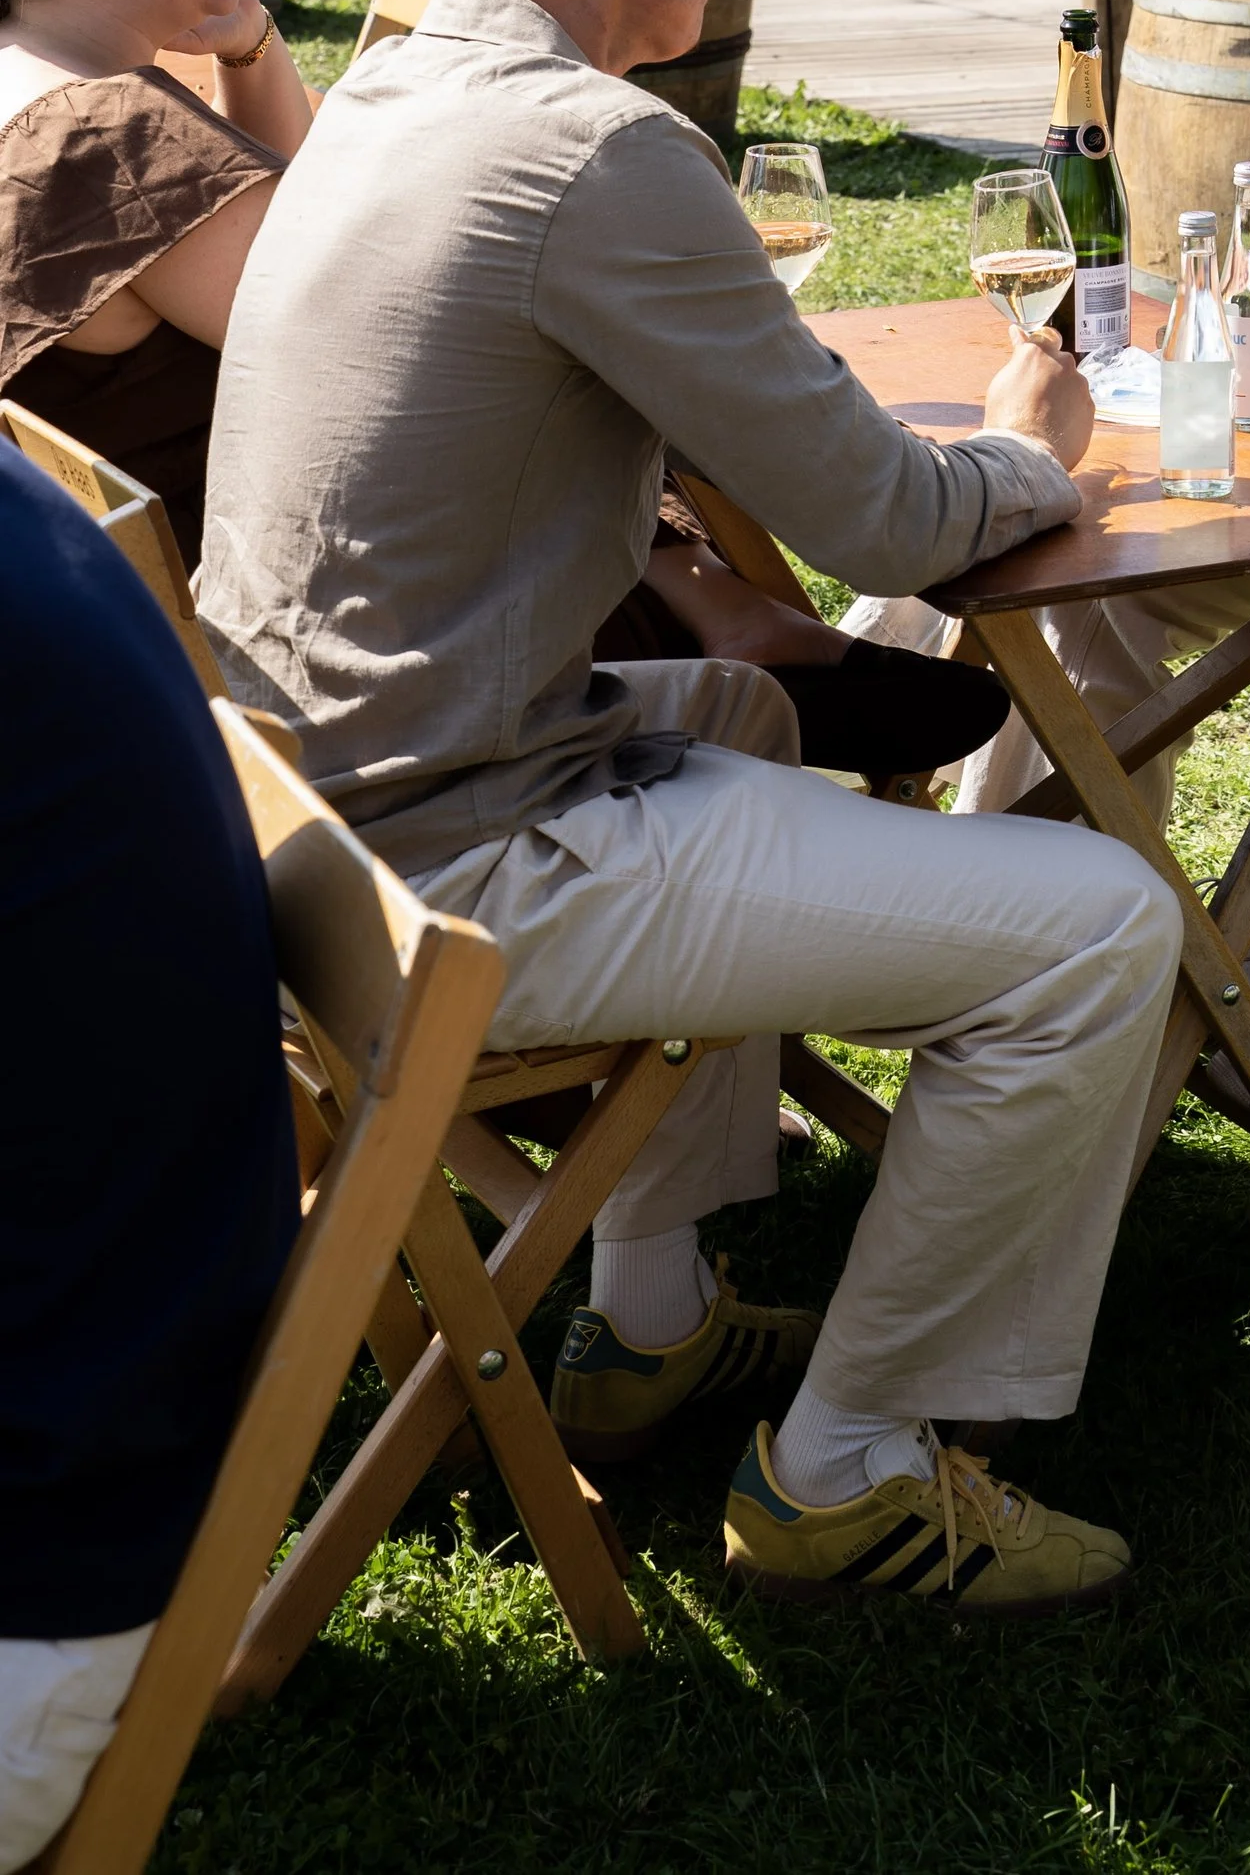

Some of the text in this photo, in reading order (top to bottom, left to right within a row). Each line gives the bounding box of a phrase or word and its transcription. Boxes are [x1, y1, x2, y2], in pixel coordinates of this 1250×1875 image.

[1084, 55, 1092, 109] CHAMPAGN
[1084, 278, 1117, 286] CHAMPAGNE
[842, 1530, 881, 1562] GAZELLE
